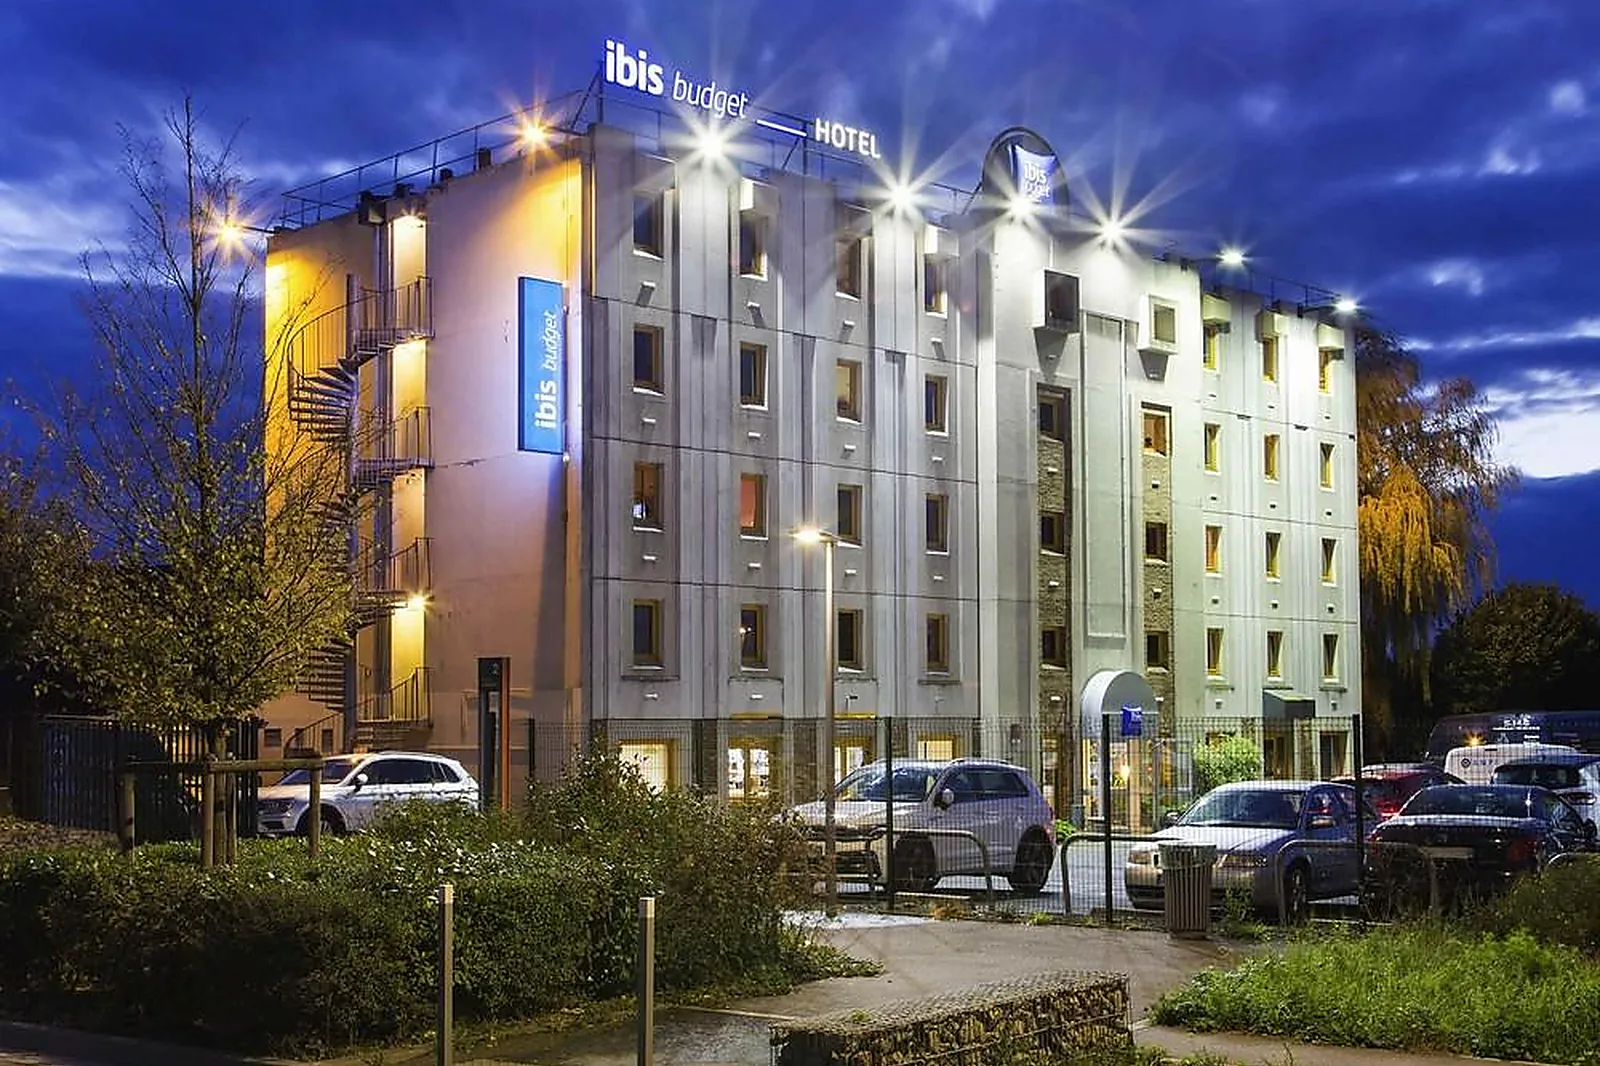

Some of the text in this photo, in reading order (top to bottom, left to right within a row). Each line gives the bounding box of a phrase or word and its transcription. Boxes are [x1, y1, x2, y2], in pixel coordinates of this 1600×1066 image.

[605, 39, 880, 159] ibis budget HOTEL
[535, 308, 561, 428] ibis budget
